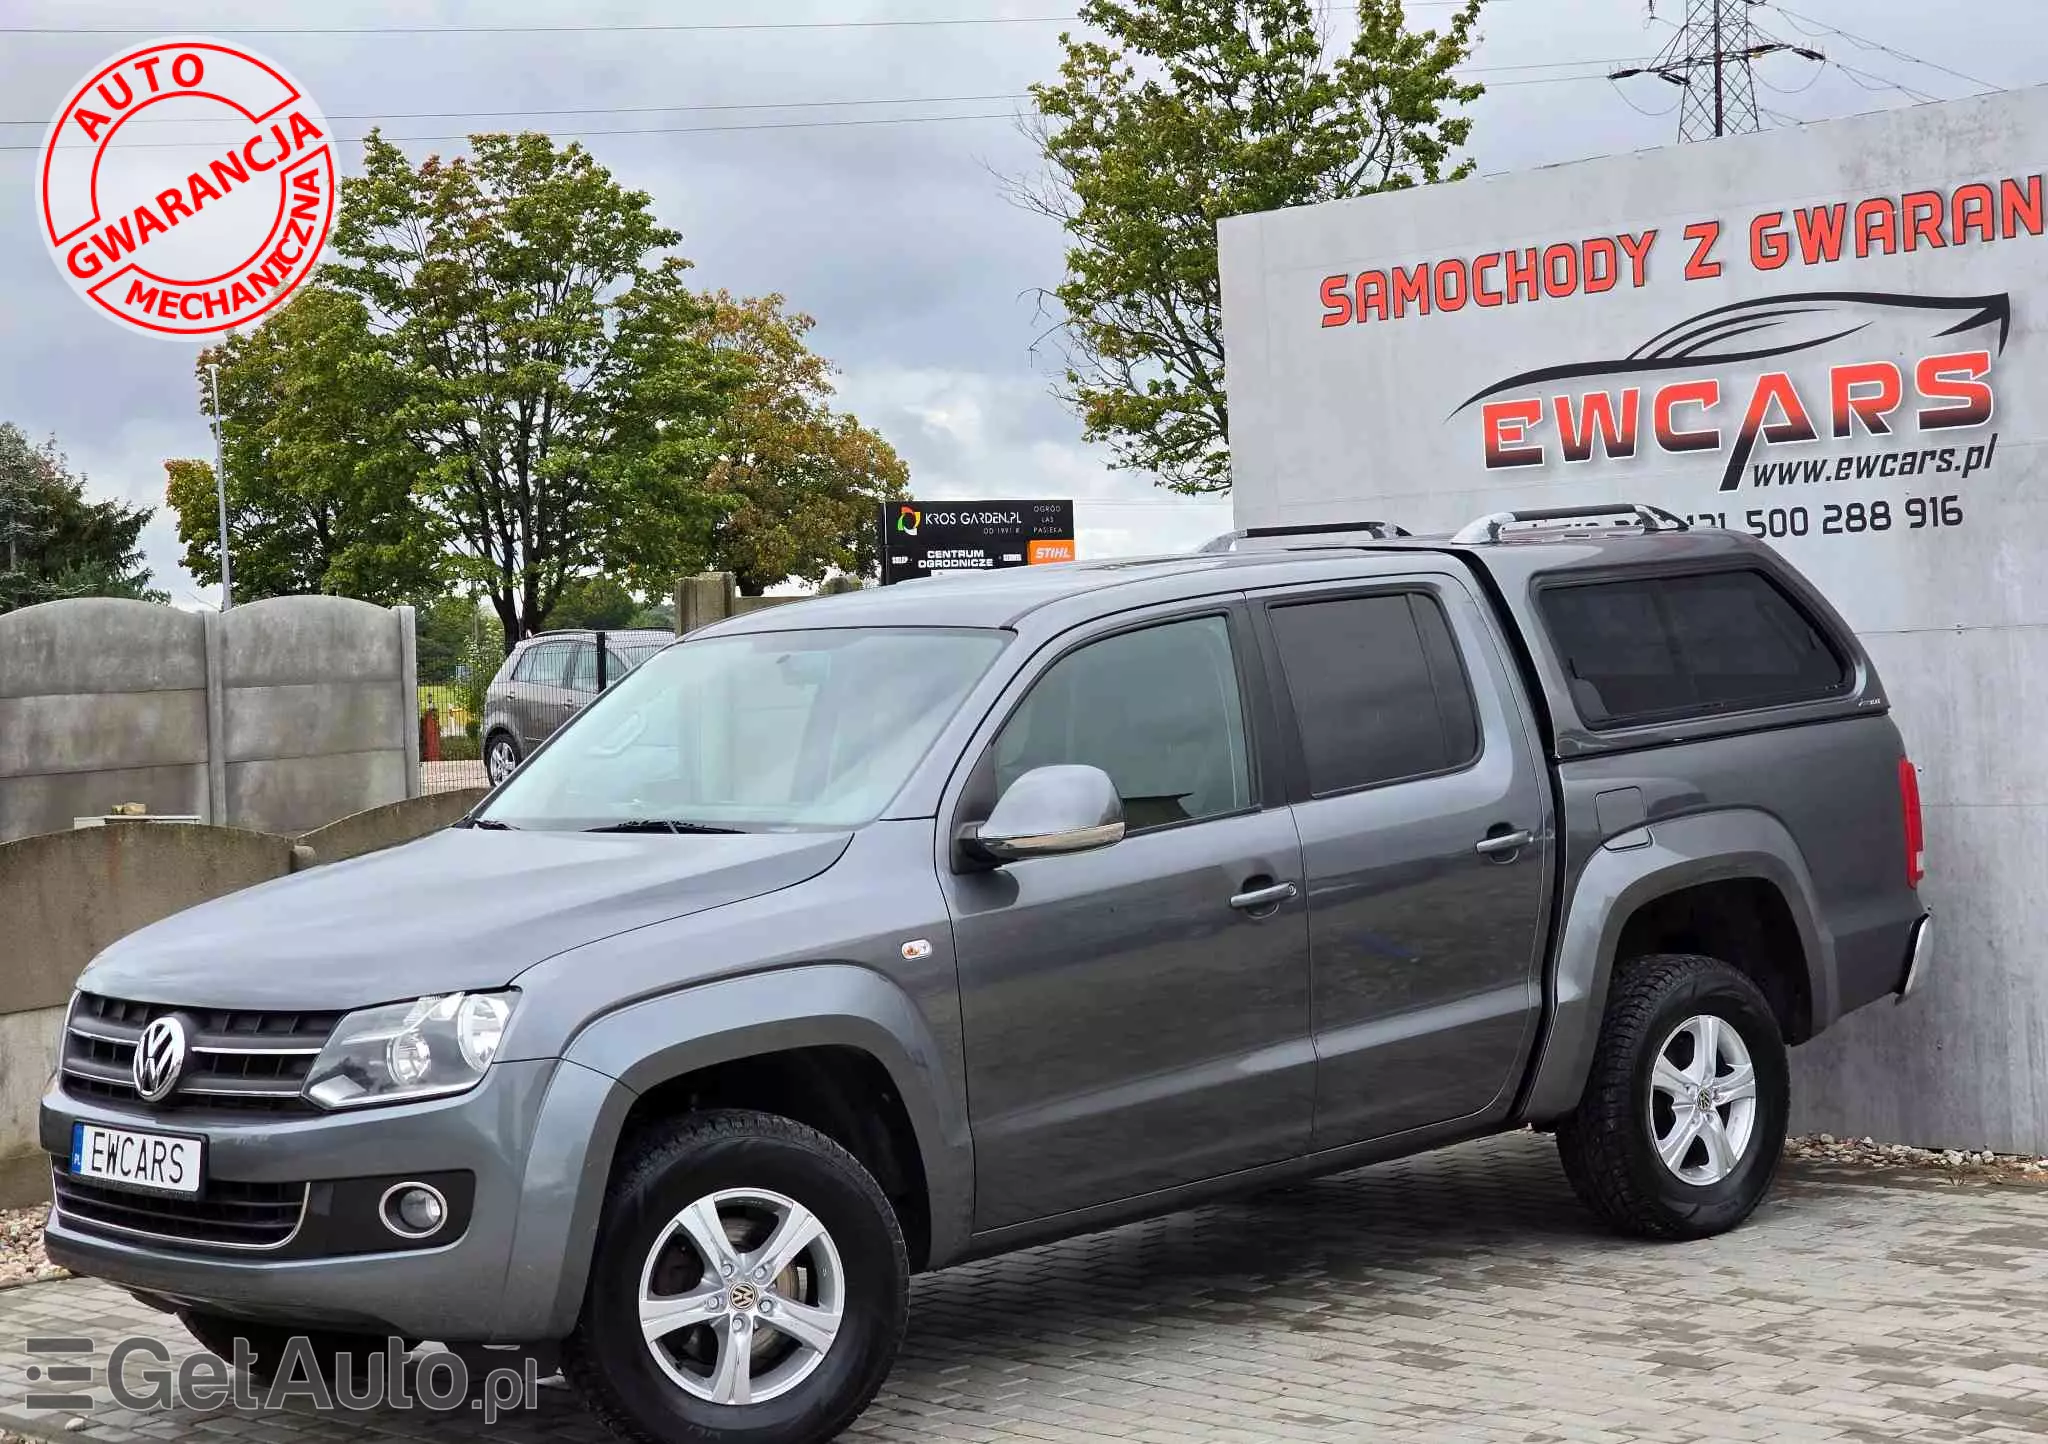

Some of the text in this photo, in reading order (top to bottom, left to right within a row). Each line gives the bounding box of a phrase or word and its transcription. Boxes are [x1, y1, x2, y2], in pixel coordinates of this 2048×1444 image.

[1320, 174, 2044, 329] SAMOCHODY Z GWARAN
[1481, 350, 1995, 492] EWCARS
[1753, 432, 1998, 488] www.ewcars.pl
[925, 511, 1022, 525] KROS GARDEN.PL
[1745, 506, 1809, 539] 500
[1822, 500, 1892, 535] 288
[1904, 494, 1963, 529] 916
[918, 558, 994, 569] OGRODNICZE
[927, 549, 984, 559] CENTRUM
[1035, 547, 1072, 559] STIHL
[91, 1131, 184, 1184] EWCARS
